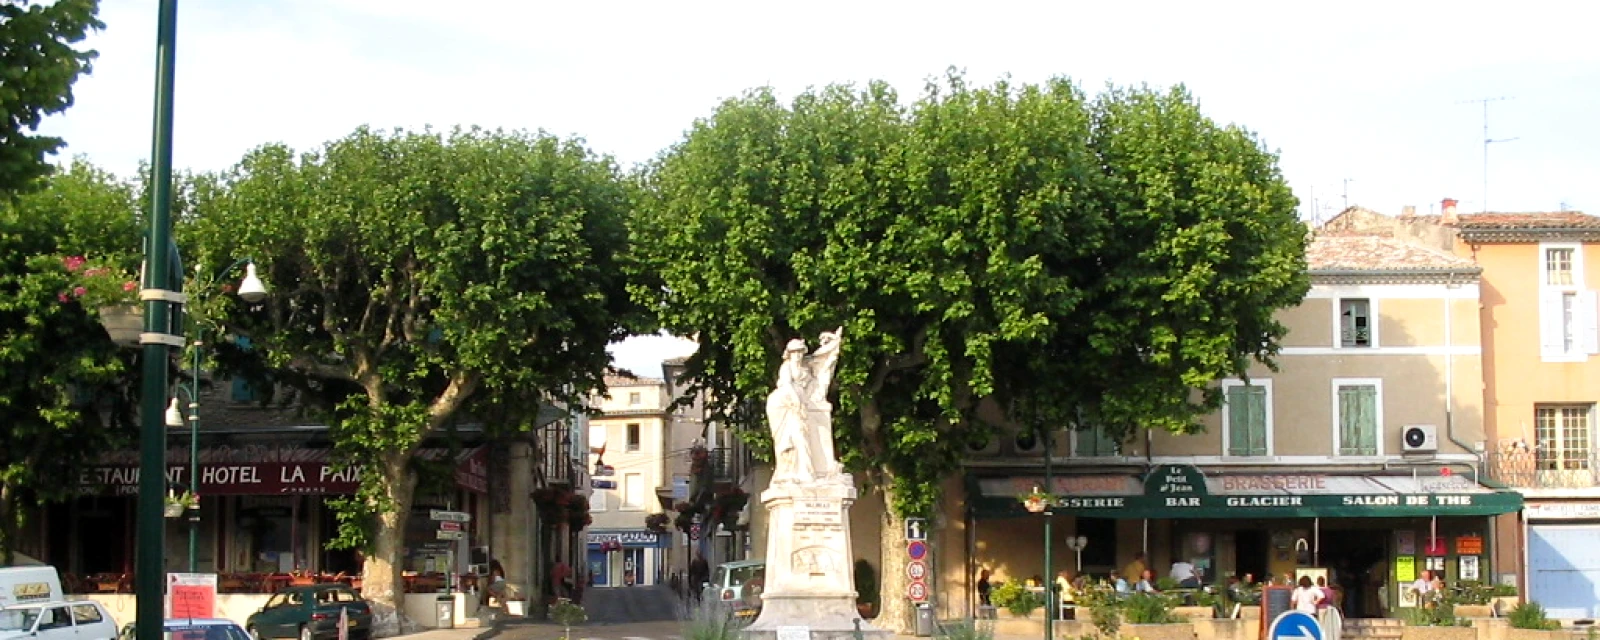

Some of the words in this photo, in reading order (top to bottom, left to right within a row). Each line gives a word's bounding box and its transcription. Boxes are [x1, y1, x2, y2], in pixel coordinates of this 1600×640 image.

[78, 466, 185, 485] ESTAUNT
[202, 466, 262, 484] HOTEL
[281, 466, 306, 483] LA
[320, 466, 363, 483] PAIX
[1223, 475, 1326, 491] BRASSERIE
[1165, 497, 1201, 507] BAR
[1226, 497, 1303, 507] GLACIER
[1342, 495, 1400, 505] SALON
[1405, 495, 1429, 505] DE
[1435, 495, 1472, 505] THE
